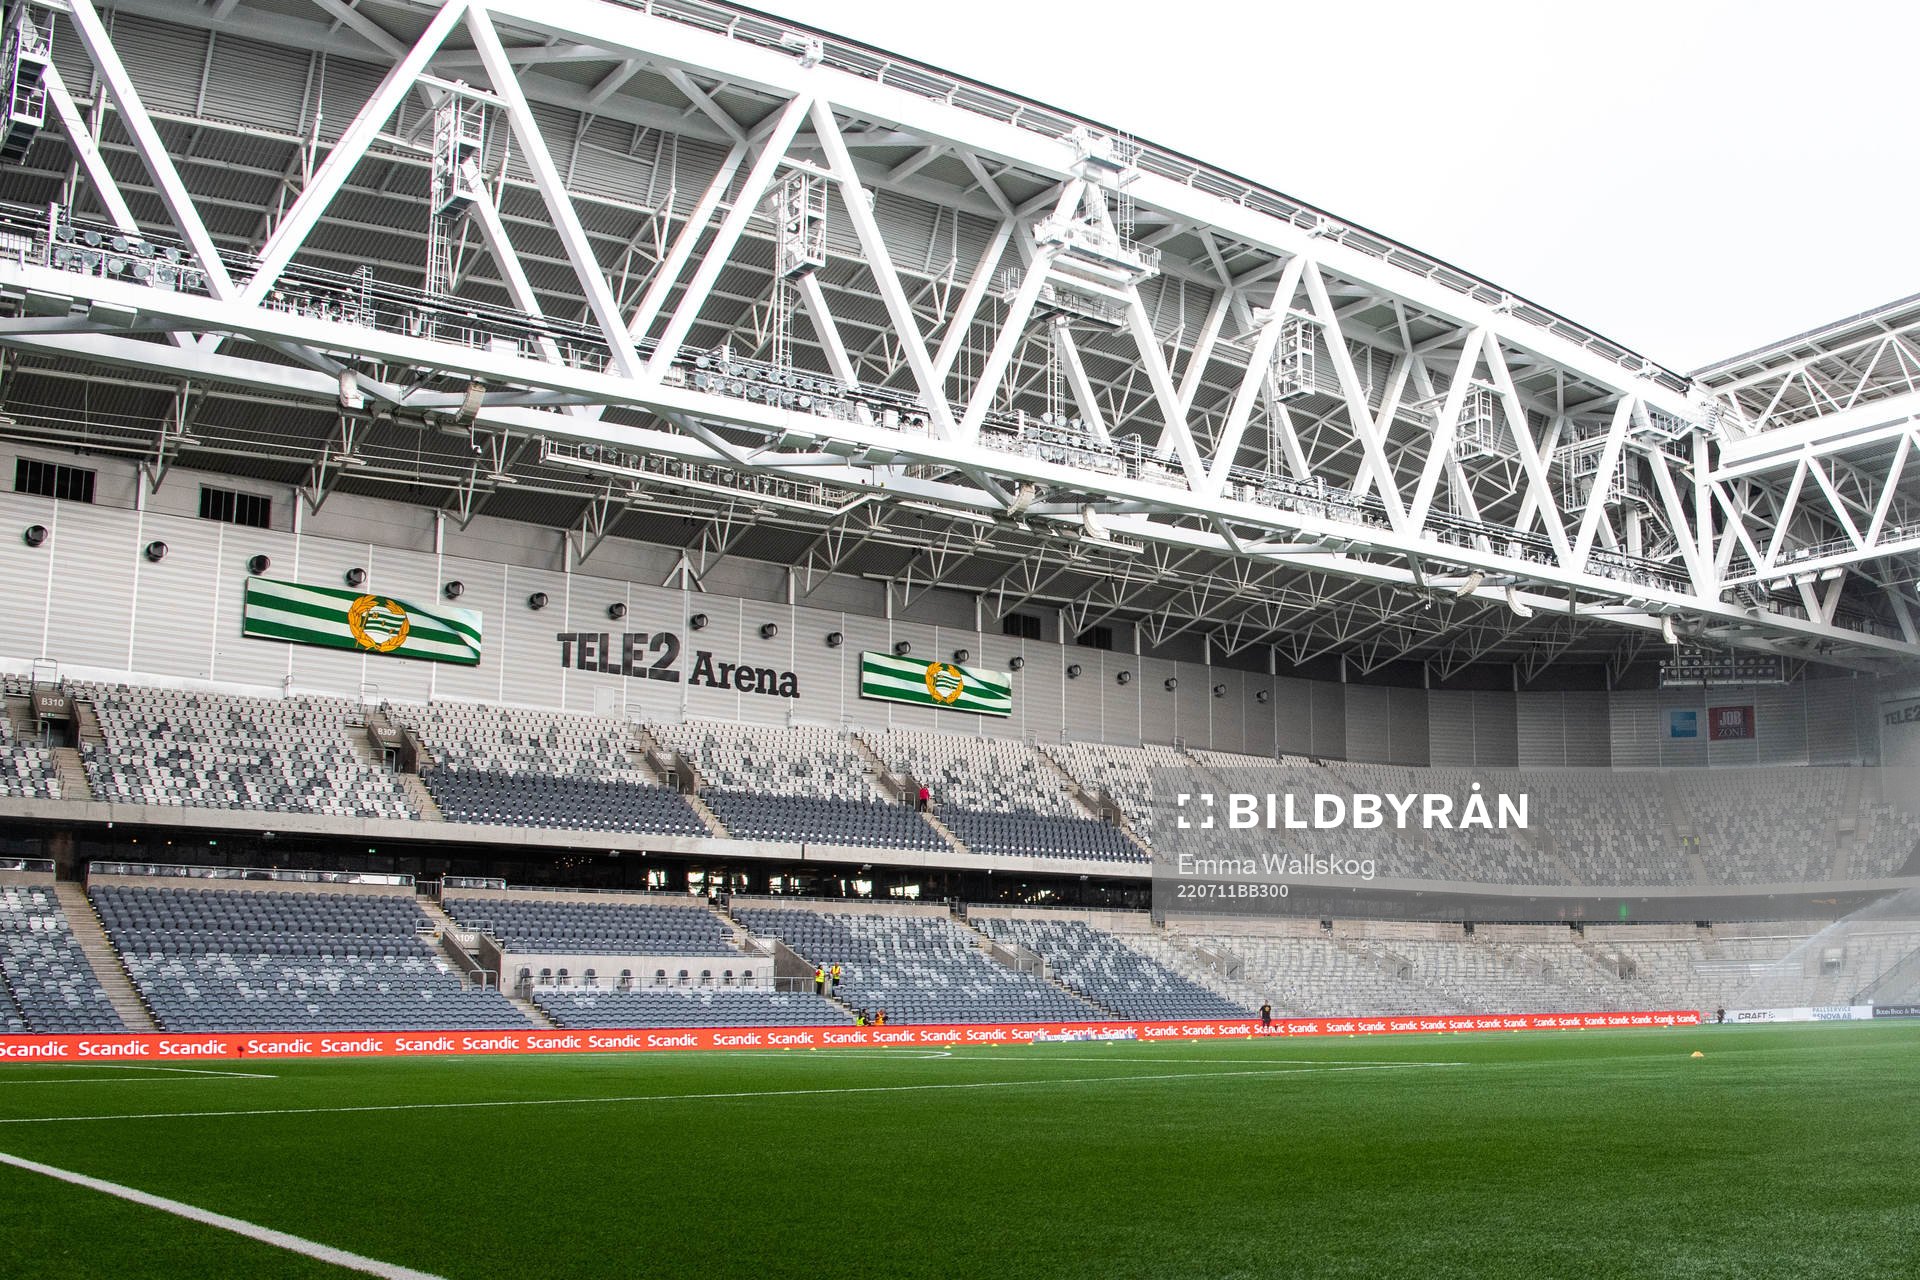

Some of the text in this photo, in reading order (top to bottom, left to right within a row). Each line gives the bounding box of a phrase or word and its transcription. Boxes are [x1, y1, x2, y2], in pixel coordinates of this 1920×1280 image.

[557, 632, 800, 698] TELE2 Arena
[41, 697, 64, 707] B310
[1719, 711, 1742, 726] JOB
[377, 727, 397, 736] B309
[1718, 727, 1747, 737] ZONE
[0, 1041, 68, 1056] Scandic
[78, 1041, 149, 1056] Scandic
[159, 1040, 226, 1055] Scandic
[248, 1038, 312, 1053] Scandic
[321, 1038, 384, 1053] Scandic
[395, 1037, 456, 1051] Scandic
[463, 1036, 520, 1050] Scandic
[527, 1035, 581, 1049] Scandic
[589, 1034, 641, 1048] Scandic
[648, 1034, 698, 1047] Scandic
[713, 1033, 761, 1046] Scandic
[768, 1032, 815, 1044] Scandic
[822, 1031, 867, 1043] Scandic
[873, 1030, 916, 1042] Scandic
[920, 1030, 962, 1041] Scandic
[967, 1029, 1007, 1040] Scandic
[1144, 1026, 1179, 1036] Scandic
[1182, 1025, 1216, 1036] Scandic
[1219, 1024, 1251, 1035] Scandic
[1288, 1023, 1318, 1033] Scandic
[1326, 1022, 1354, 1032] Scandic
[1358, 1022, 1386, 1031] Scandic
[1390, 1021, 1417, 1031] Scandic
[1420, 1020, 1446, 1030] Scandic
[1449, 1019, 1474, 1029] Scandic
[1477, 1019, 1501, 1028] Scandic
[1503, 1018, 1527, 1028] Scandic
[1559, 1017, 1581, 1026] Scandic
[1584, 1016, 1607, 1026] Scandic
[1608, 1016, 1630, 1025] Scandic
[1631, 1015, 1653, 1025] Scandic
[1677, 1014, 1698, 1023] Scandic
